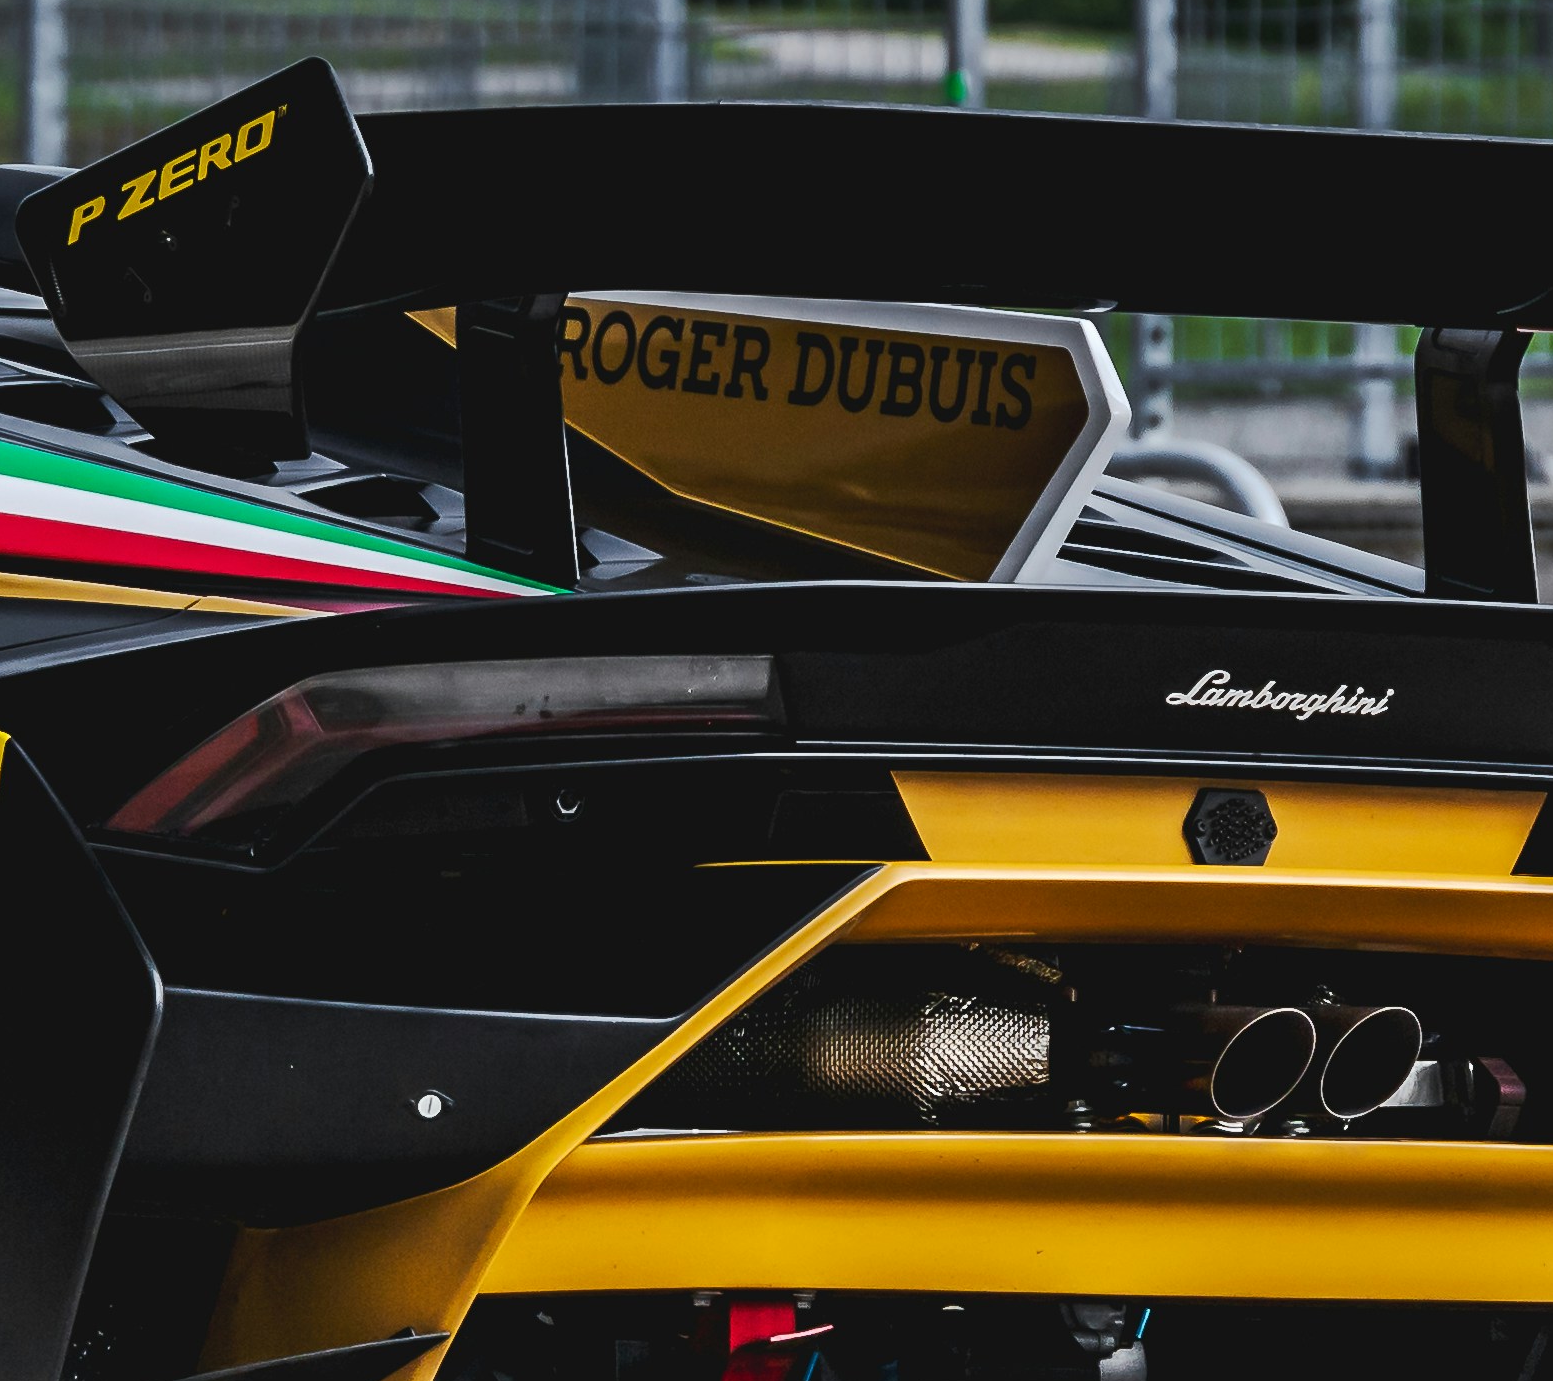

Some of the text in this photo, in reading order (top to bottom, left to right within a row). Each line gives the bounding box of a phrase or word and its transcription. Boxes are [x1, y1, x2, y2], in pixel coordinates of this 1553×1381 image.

[67, 195, 106, 246] P
[117, 110, 276, 221] ZERO
[557, 304, 1037, 431] ROGER DUBUIS
[1165, 669, 1395, 720] Lamborghini
